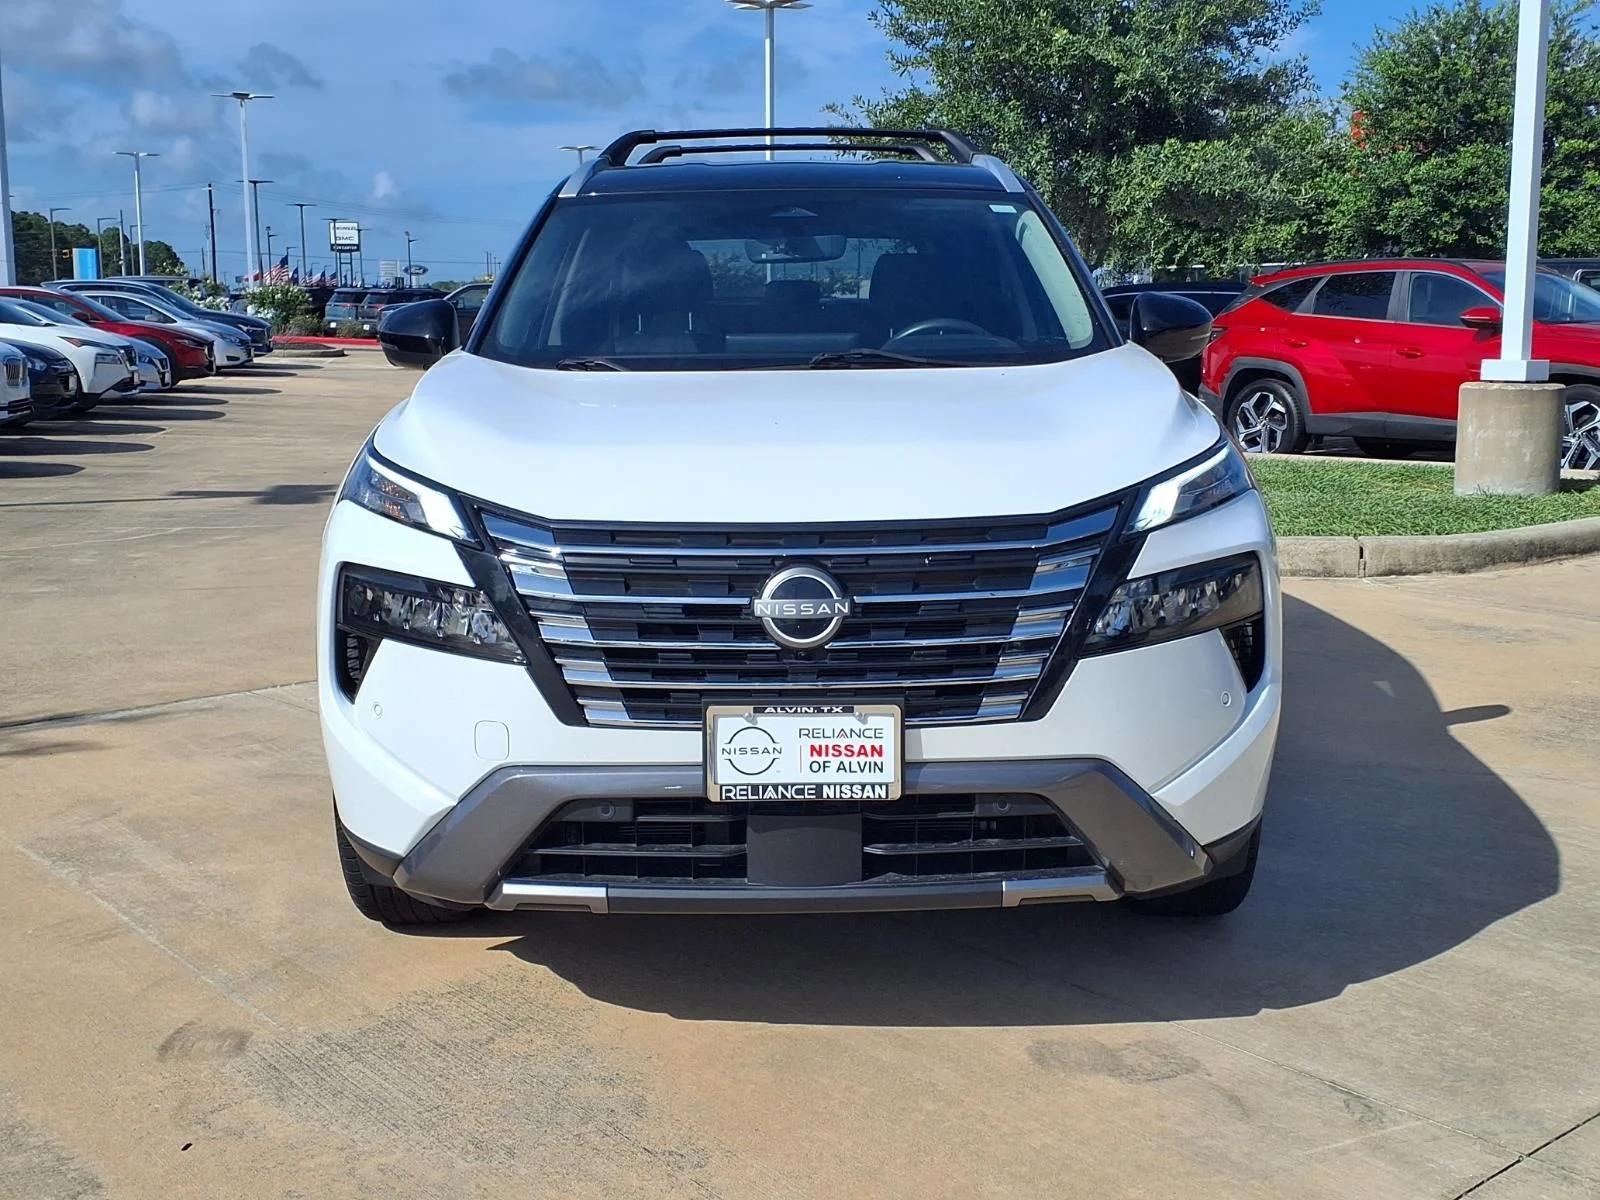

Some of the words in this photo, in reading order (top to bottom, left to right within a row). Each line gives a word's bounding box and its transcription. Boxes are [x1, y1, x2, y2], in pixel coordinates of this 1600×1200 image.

[757, 602, 849, 615] NISSAN
[799, 728, 884, 739] RELIANCE
[722, 747, 782, 755] NISSAN
[810, 744, 883, 757] NISSAN
[809, 761, 831, 773] OF
[836, 761, 884, 773] ALVIN
[722, 785, 816, 800] RELIANCE
[822, 784, 887, 799] NISSAN
